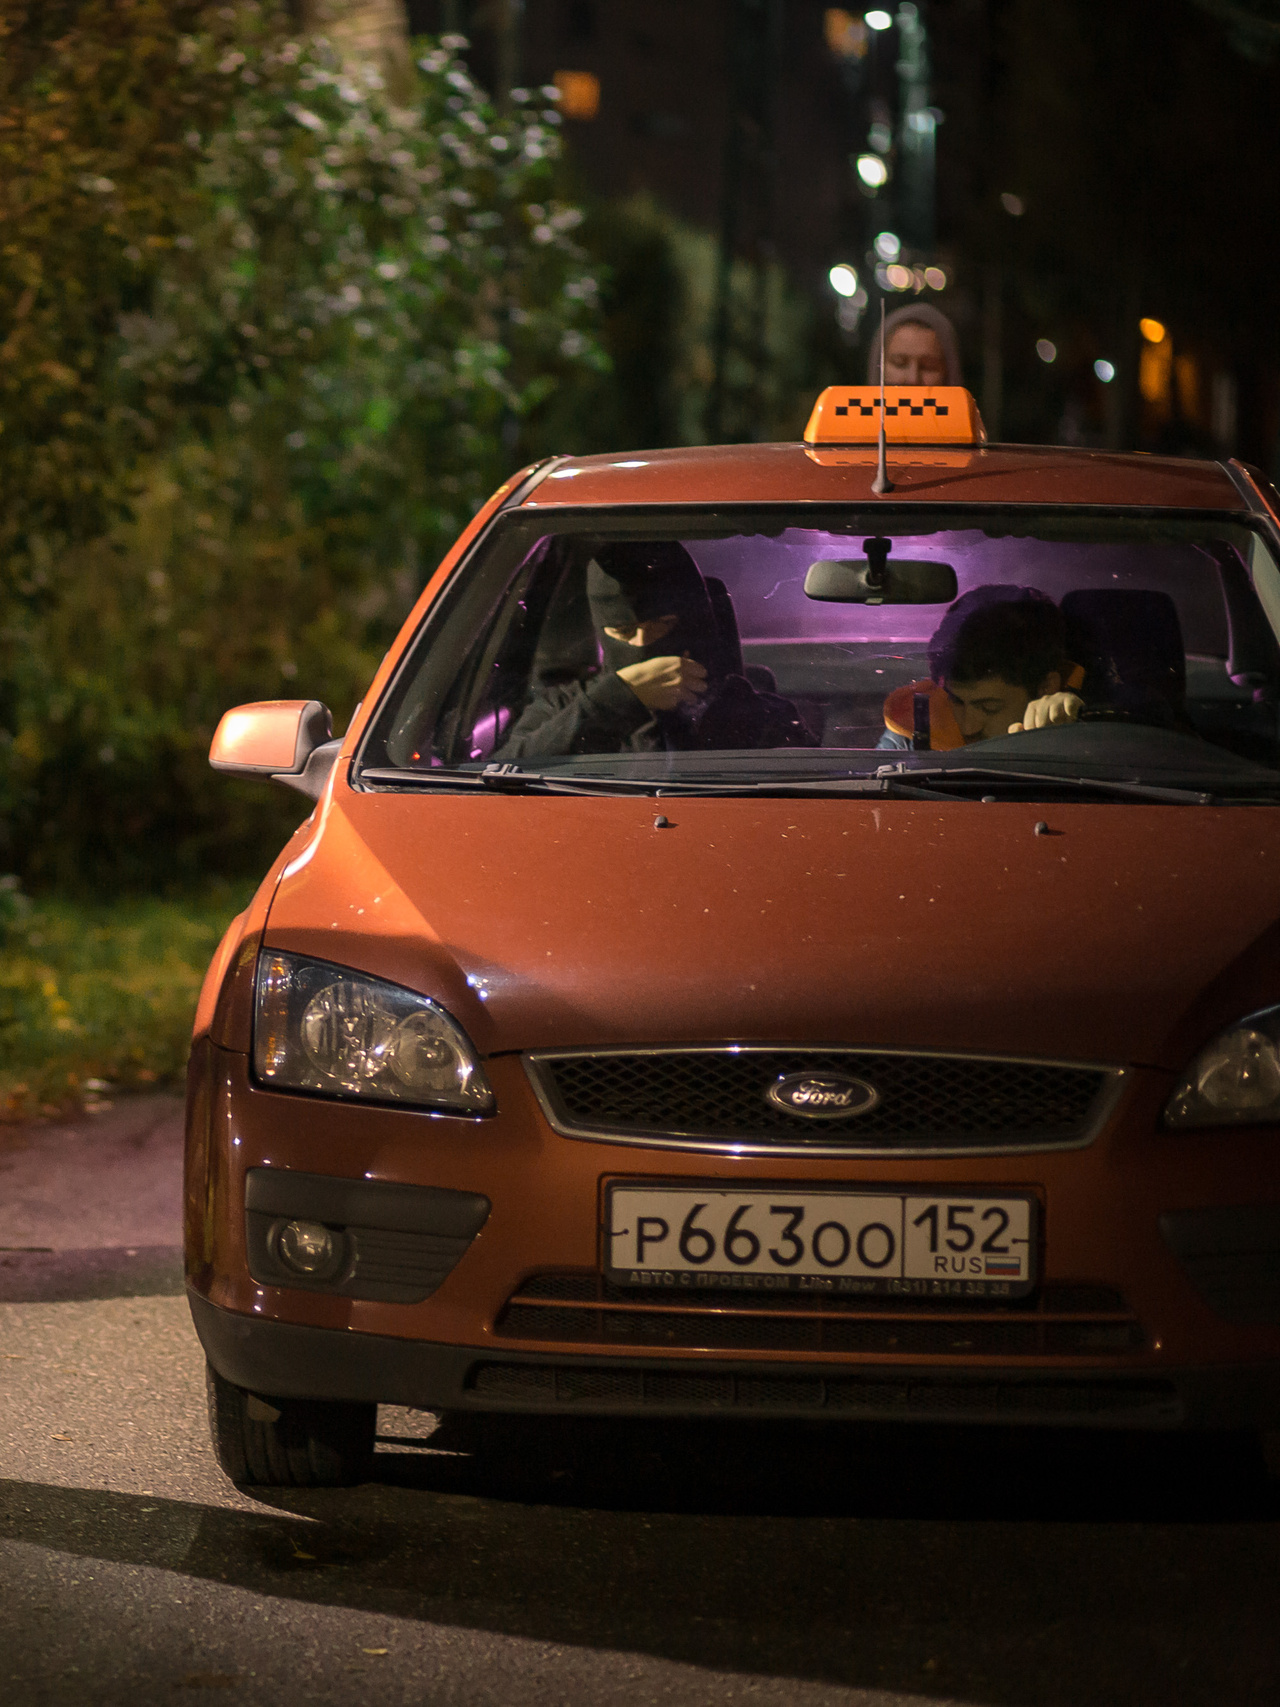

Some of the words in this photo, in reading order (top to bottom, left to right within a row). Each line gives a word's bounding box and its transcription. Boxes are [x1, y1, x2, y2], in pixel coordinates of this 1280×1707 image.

[792, 1079, 854, 1105] Ford
[913, 1204, 1010, 1255] 152
[934, 1256, 982, 1274] RUS
